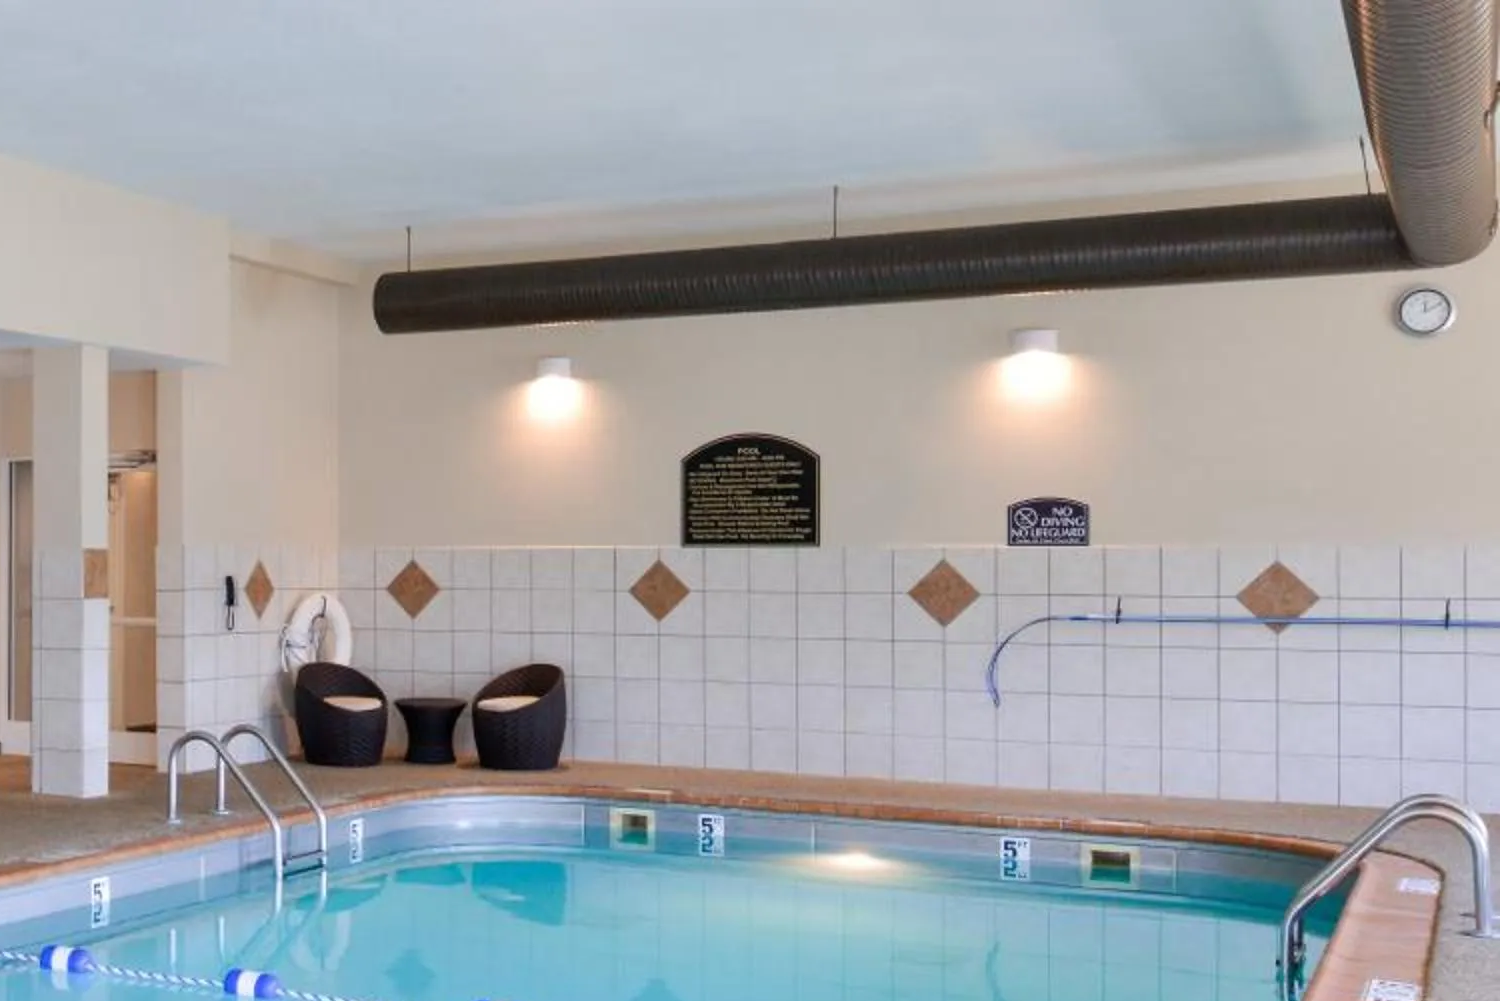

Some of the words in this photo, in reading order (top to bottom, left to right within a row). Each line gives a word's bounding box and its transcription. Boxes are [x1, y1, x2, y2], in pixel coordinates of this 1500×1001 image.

[1051, 505, 1073, 517] NO
[1041, 516, 1085, 527] DIVING
[1011, 527, 1029, 537] NO
[1031, 527, 1085, 537] LIFEGUARD
